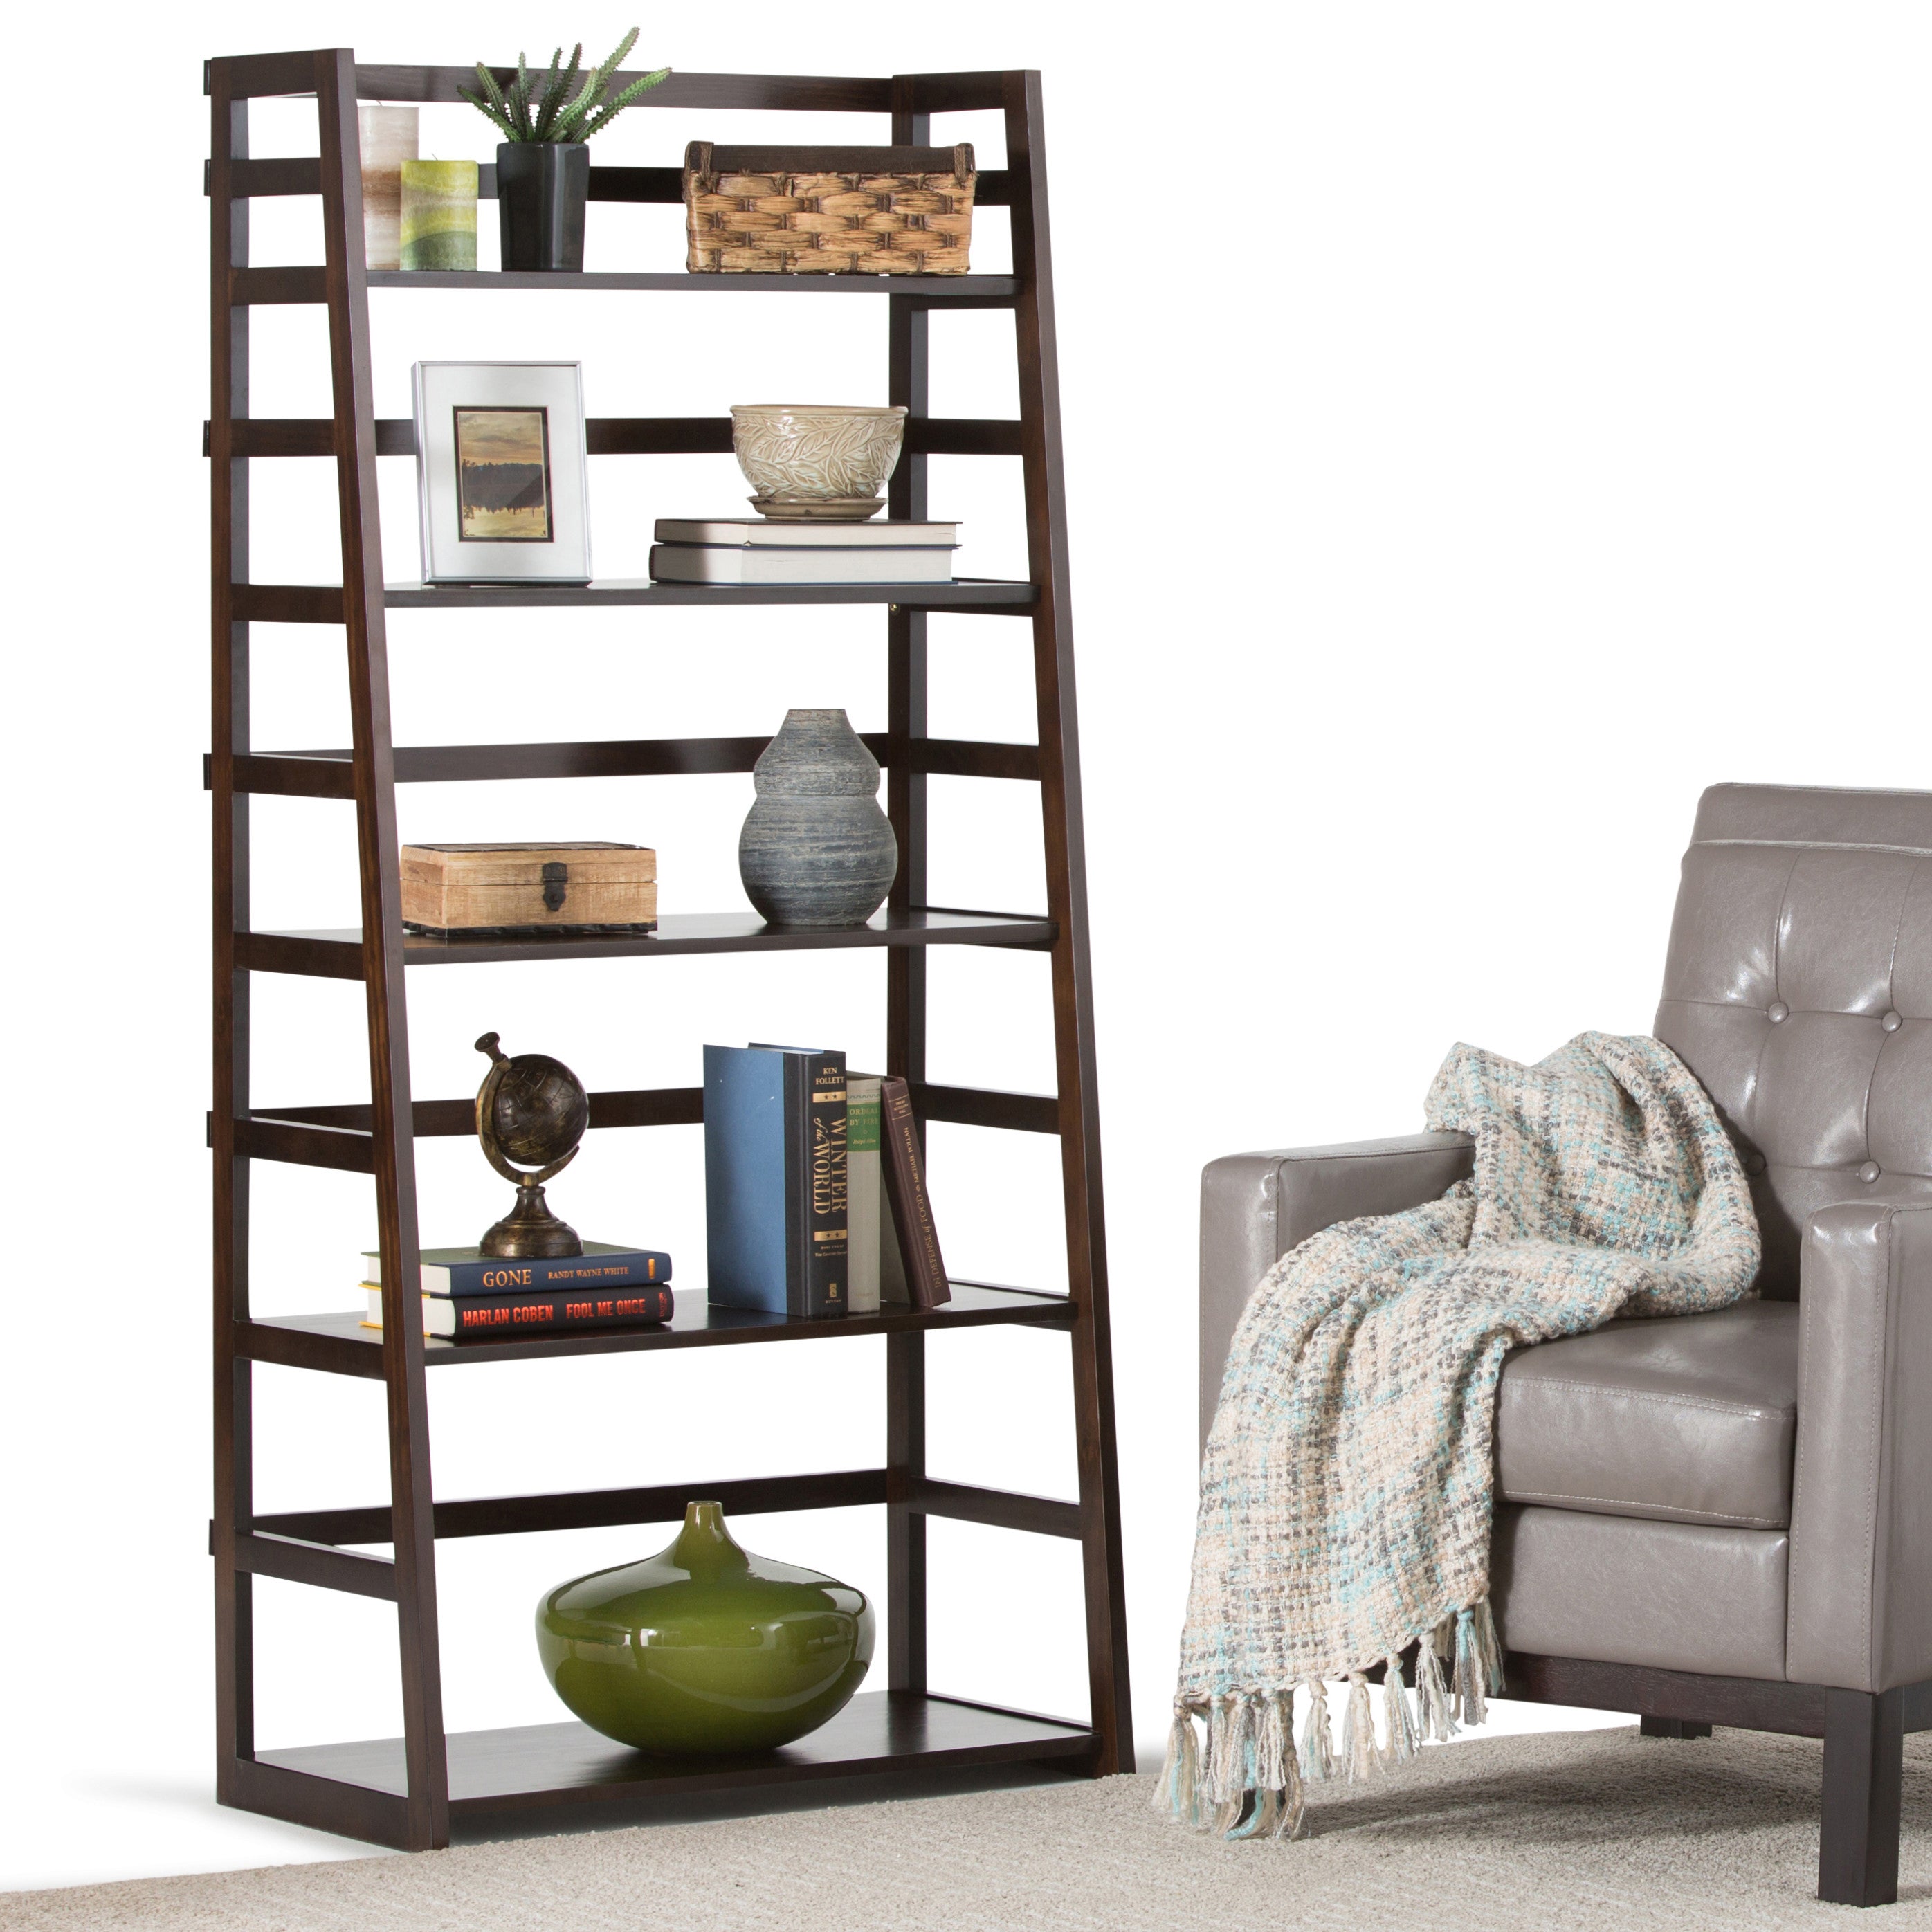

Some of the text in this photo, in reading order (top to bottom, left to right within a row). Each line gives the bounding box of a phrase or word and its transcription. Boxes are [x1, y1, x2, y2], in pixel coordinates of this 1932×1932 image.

[815, 1076, 845, 1085] FOLLETT
[813, 1118, 830, 1214] of the WORLD
[830, 1117, 847, 1212] WINTER
[903, 1127, 920, 1183] MICHAEL POLLAN
[915, 1194, 942, 1288] IN DEFENSE of FOOD
[483, 1266, 629, 1287] GONE RANDY WAYNE WHITE
[462, 1308, 510, 1327] HARLAN
[513, 1304, 554, 1323] COBEN
[566, 1302, 594, 1318] FOOL
[596, 1301, 614, 1317] ME
[616, 1298, 646, 1315] ONCE
